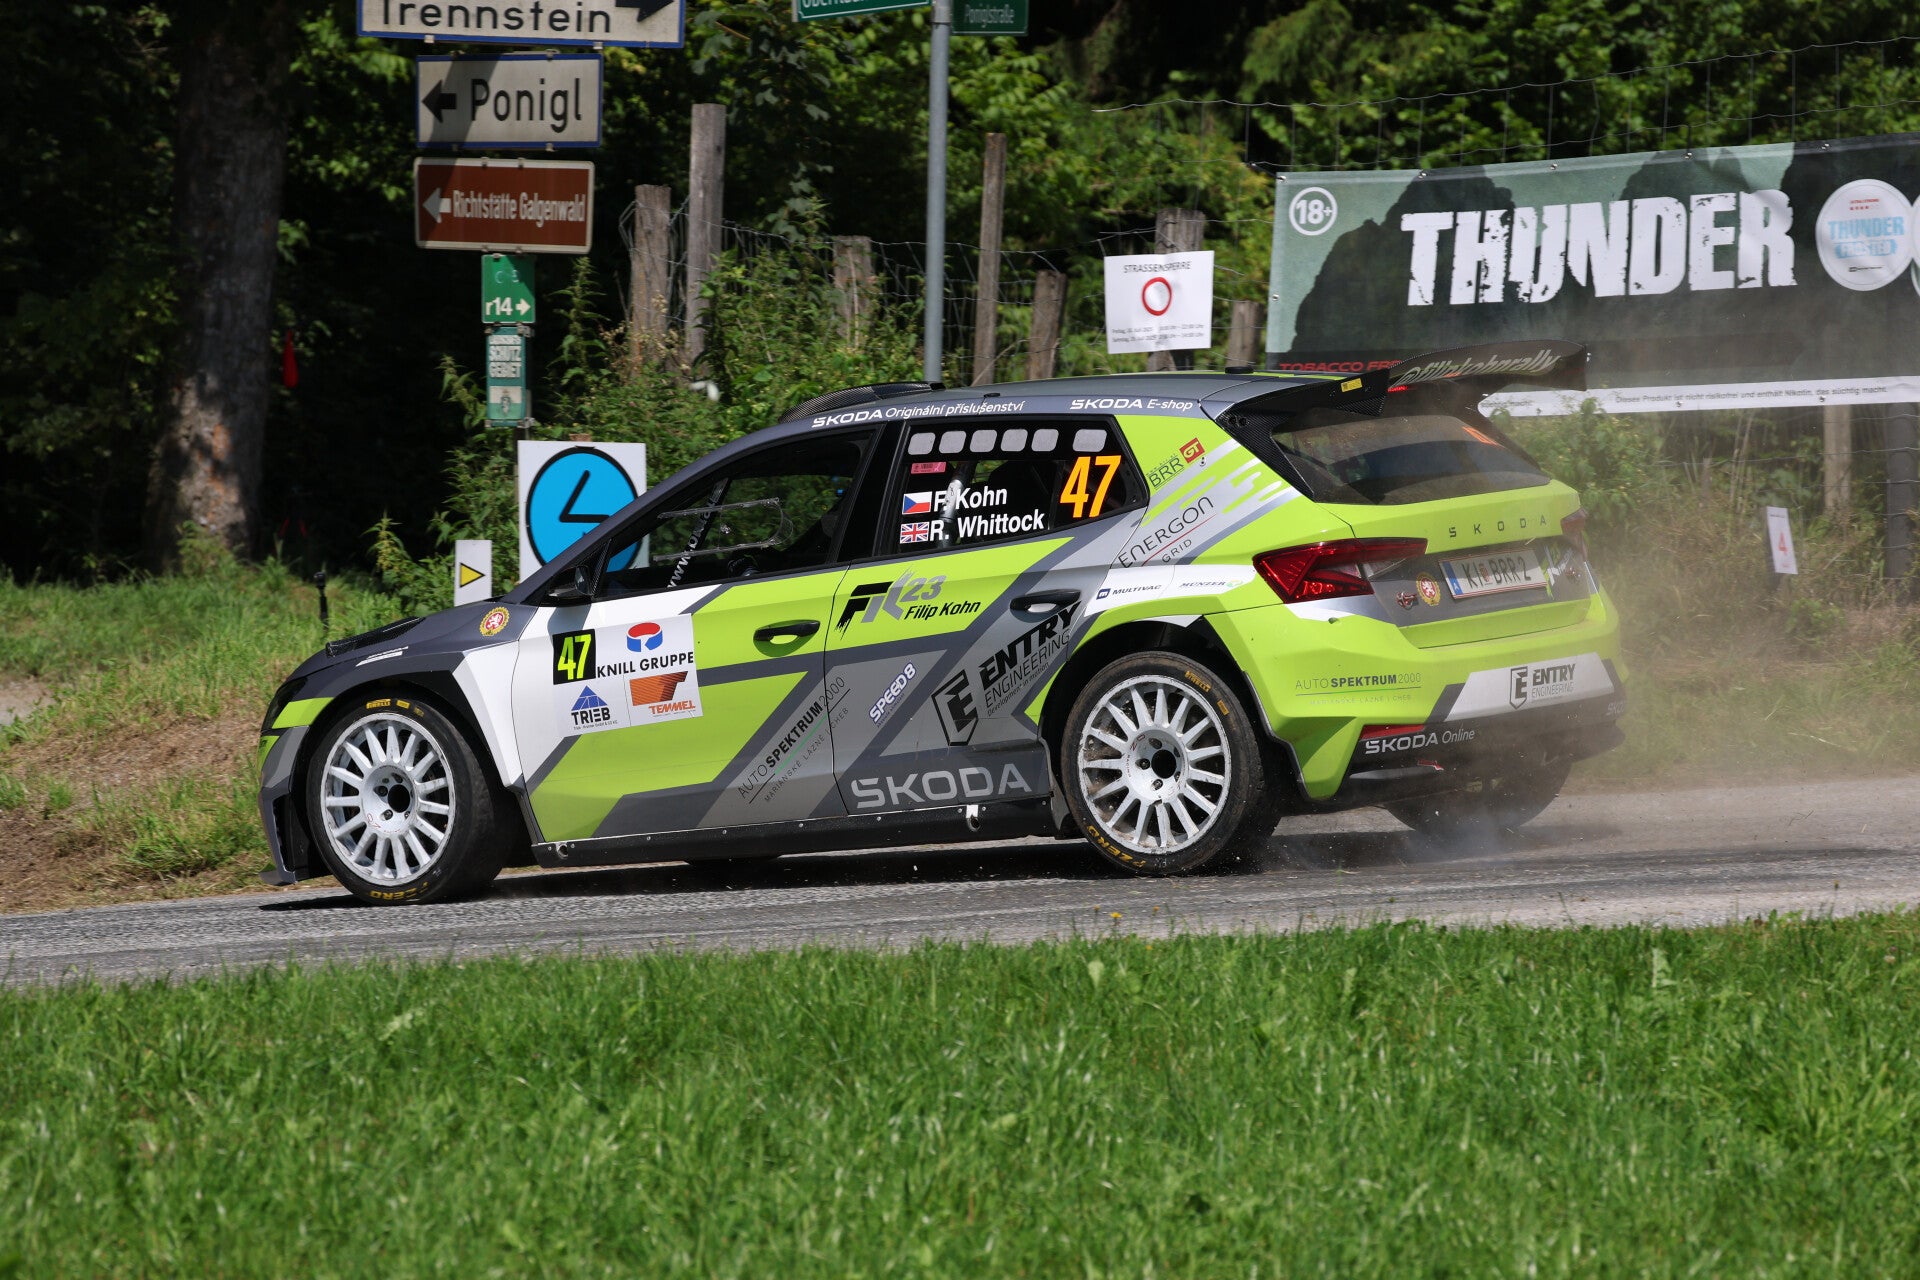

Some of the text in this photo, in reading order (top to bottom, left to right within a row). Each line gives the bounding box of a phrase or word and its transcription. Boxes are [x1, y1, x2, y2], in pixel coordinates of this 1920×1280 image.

[471, 78, 582, 133] Ponigl
[453, 190, 587, 228] Richtstätte Galgenwald
[1294, 198, 1333, 226] 18+
[1828, 216, 1905, 240] THUNDER
[1401, 190, 1799, 307] THUNDER
[1123, 261, 1192, 273] STRASSENSPERRE
[485, 297, 513, 316] r14
[1280, 361, 1364, 372] TOBACCO
[1146, 399, 1194, 412] E-shop
[1615, 395, 1640, 403] Dieses
[1642, 394, 1671, 402] Produkt
[1674, 393, 1684, 401] ist
[1686, 392, 1704, 400] nicht
[884, 404, 945, 421] Originální
[944, 400, 1027, 417] příslušenství
[1149, 457, 1186, 488] BRR
[1059, 455, 1122, 518] 47
[955, 487, 1008, 510] Kohn
[929, 509, 1045, 541] R. Whittock
[1118, 496, 1214, 569] ENERGON
[1161, 539, 1193, 563] GRID
[1112, 584, 1162, 595] MULTIVAC
[904, 601, 981, 621] Filip Kohn
[557, 634, 592, 680] 47
[978, 600, 1081, 691] ENTRY
[597, 652, 694, 678] KNILL GRUPPE
[984, 628, 1071, 708] ENGINEERING
[1532, 663, 1576, 686] ENTRY
[1531, 682, 1575, 698] ENGINEERING
[366, 698, 391, 710] PIRELLI
[648, 700, 696, 714] TEMMEL
[571, 707, 611, 725] TRIEB
[1441, 728, 1475, 744] Online
[1087, 825, 1134, 862] ZERO
